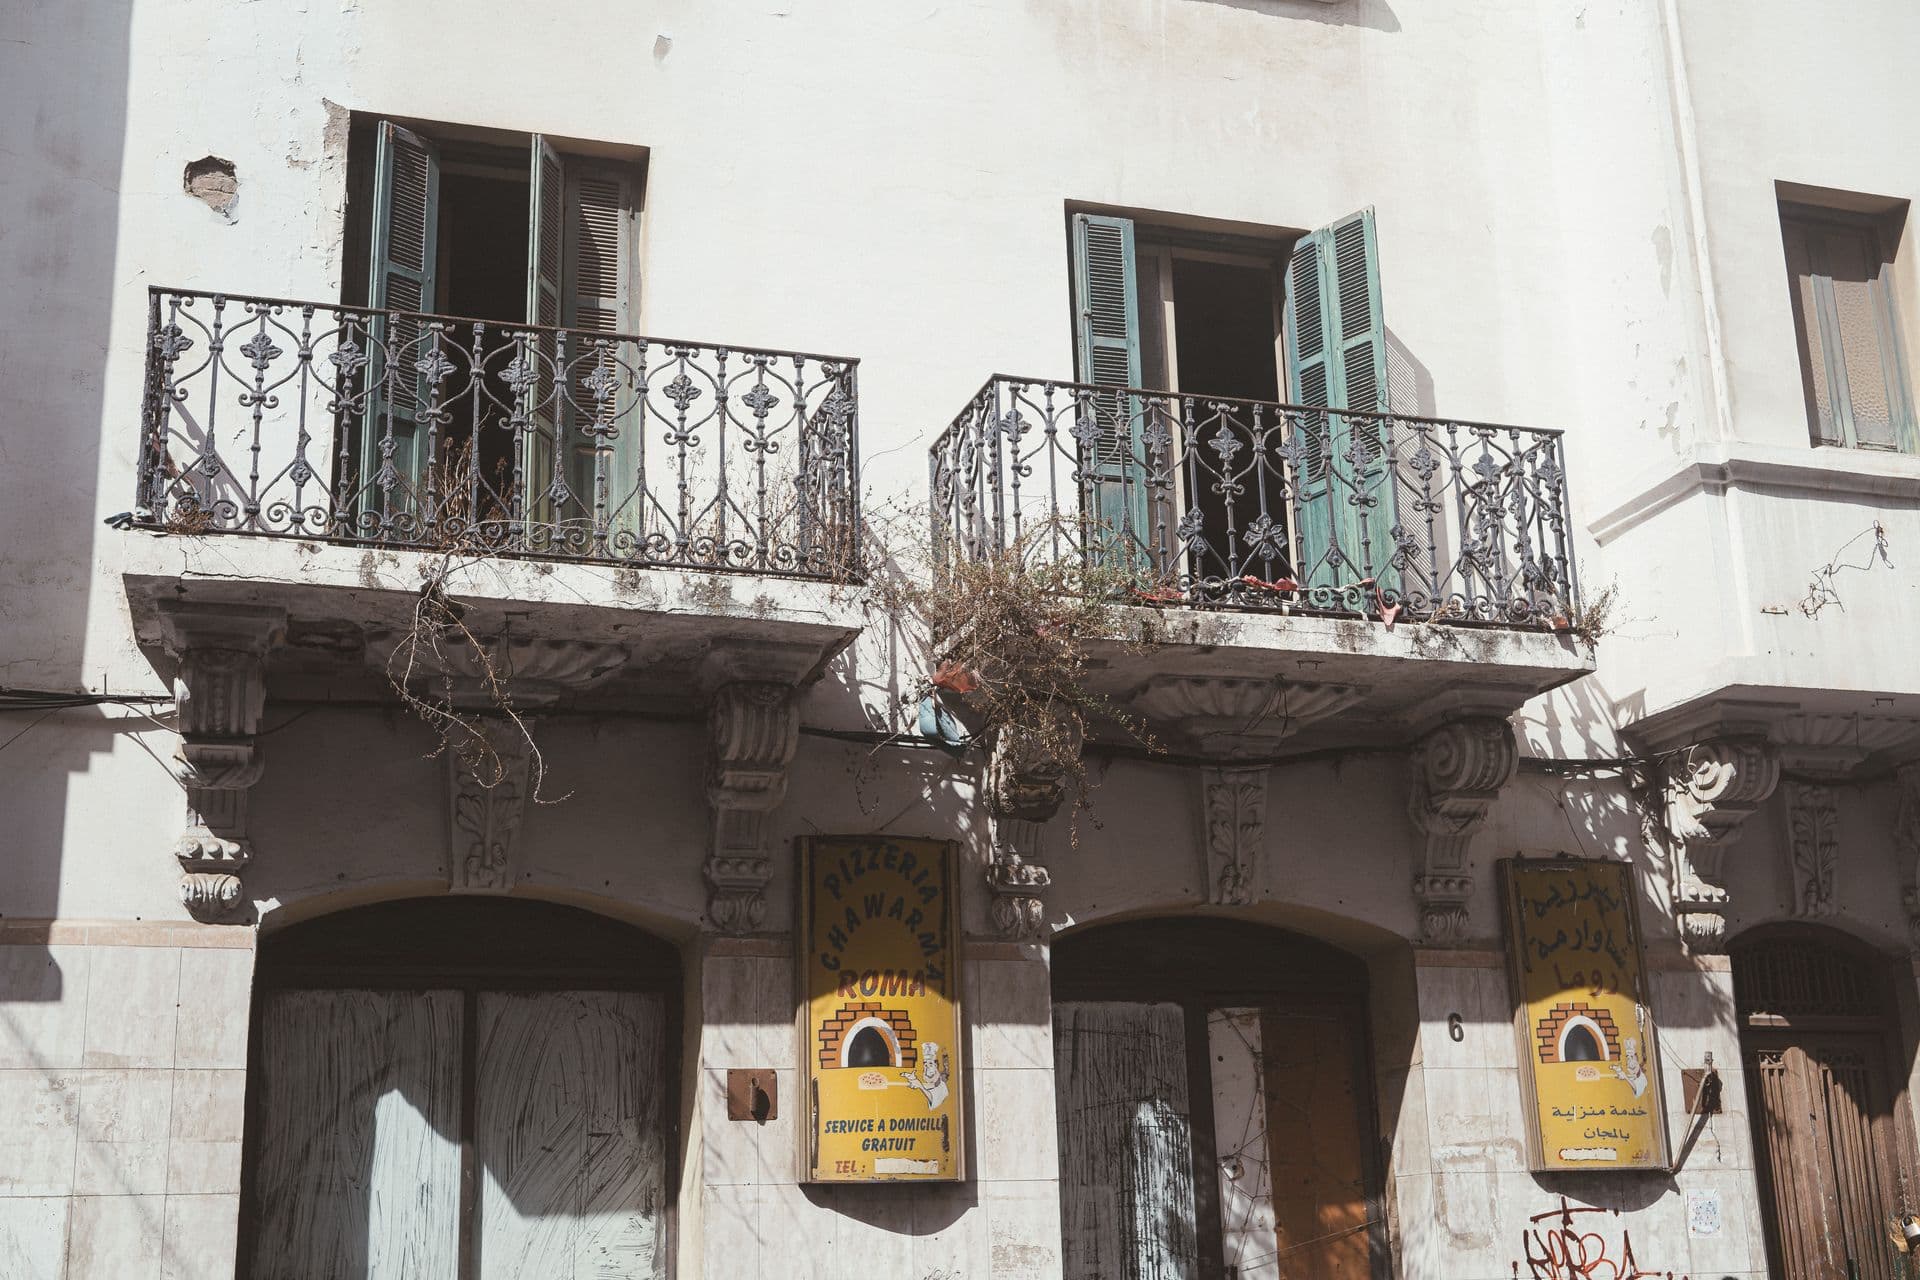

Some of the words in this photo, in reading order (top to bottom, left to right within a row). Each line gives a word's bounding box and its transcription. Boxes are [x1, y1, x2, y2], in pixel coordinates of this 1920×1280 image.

[824, 843, 938, 904] PIZZERIA
[820, 891, 945, 981] CHAWARMA
[837, 968, 926, 998] ROMA
[1552, 959, 1619, 997] روما
[1447, 1012, 1464, 1042] 6
[1552, 1105, 1606, 1121] منزلية
[1609, 1105, 1647, 1116] خدمة
[824, 1118, 875, 1133] SERVICE
[877, 1118, 886, 1132] A
[1583, 1126, 1630, 1142] بالمجان
[861, 1137, 916, 1152] GRATUIT
